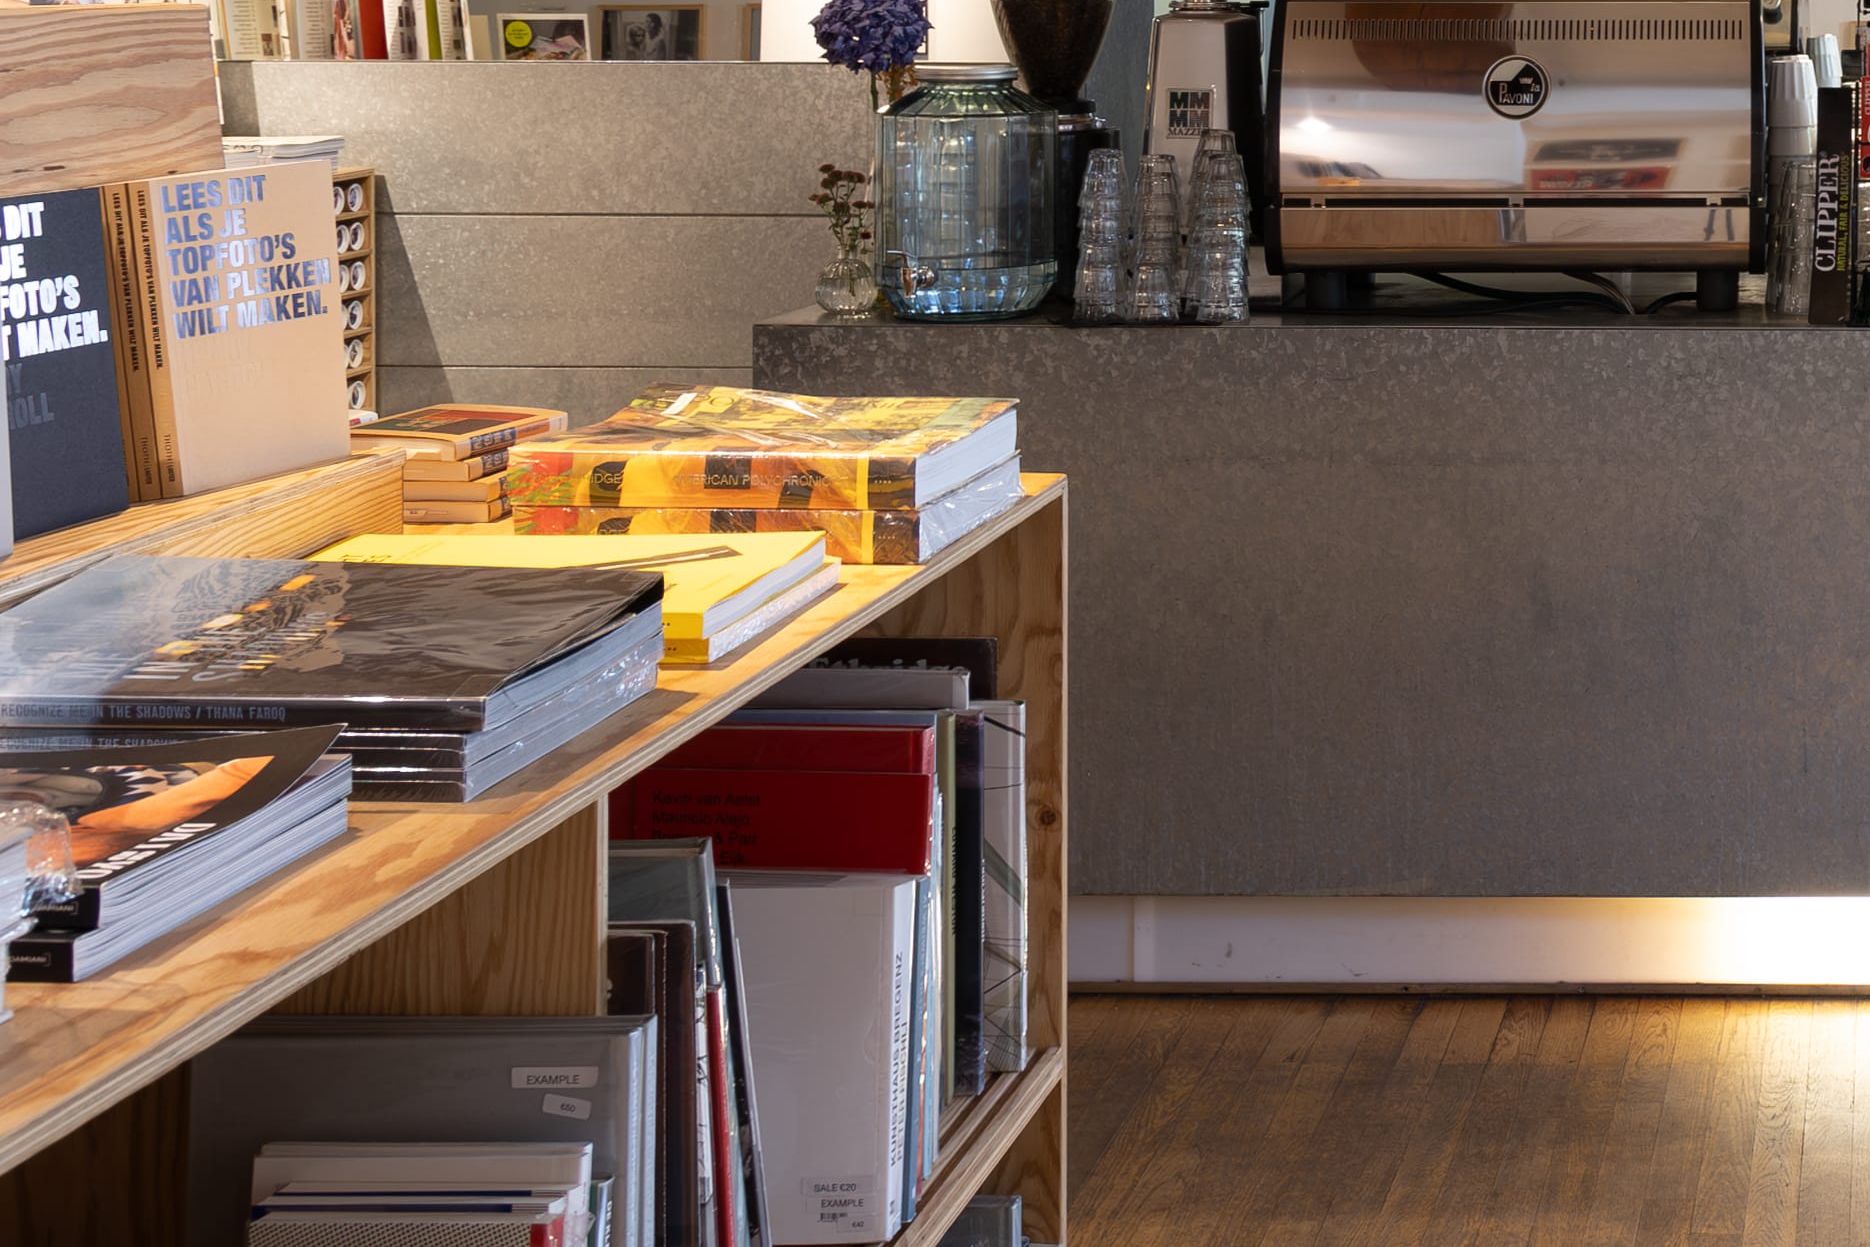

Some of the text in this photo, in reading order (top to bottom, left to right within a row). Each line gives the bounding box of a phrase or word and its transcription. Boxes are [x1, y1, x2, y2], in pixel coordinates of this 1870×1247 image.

[1498, 82, 1534, 104] PAVONI
[137, 190, 145, 207] LEES
[161, 174, 266, 213] LEES DIT
[1815, 153, 1840, 272] CLIPPER
[6, 201, 44, 241] DIT
[166, 208, 248, 245] ALS JE
[166, 233, 296, 276] TOPFOTO'S
[170, 257, 331, 308] VAN PLEKKEN
[173, 290, 328, 340] WILT MAKEN.
[109, 705, 131, 719] THE
[136, 705, 191, 720] SHADOWS
[206, 706, 243, 720] THANA
[249, 706, 286, 722] FAROQ
[526, 1074, 581, 1085] EXAMPLE
[890, 1049, 900, 1167] KUNSTHAUS
[813, 1183, 857, 1192] SALE €20
[821, 1198, 864, 1208] EXAMPLE
